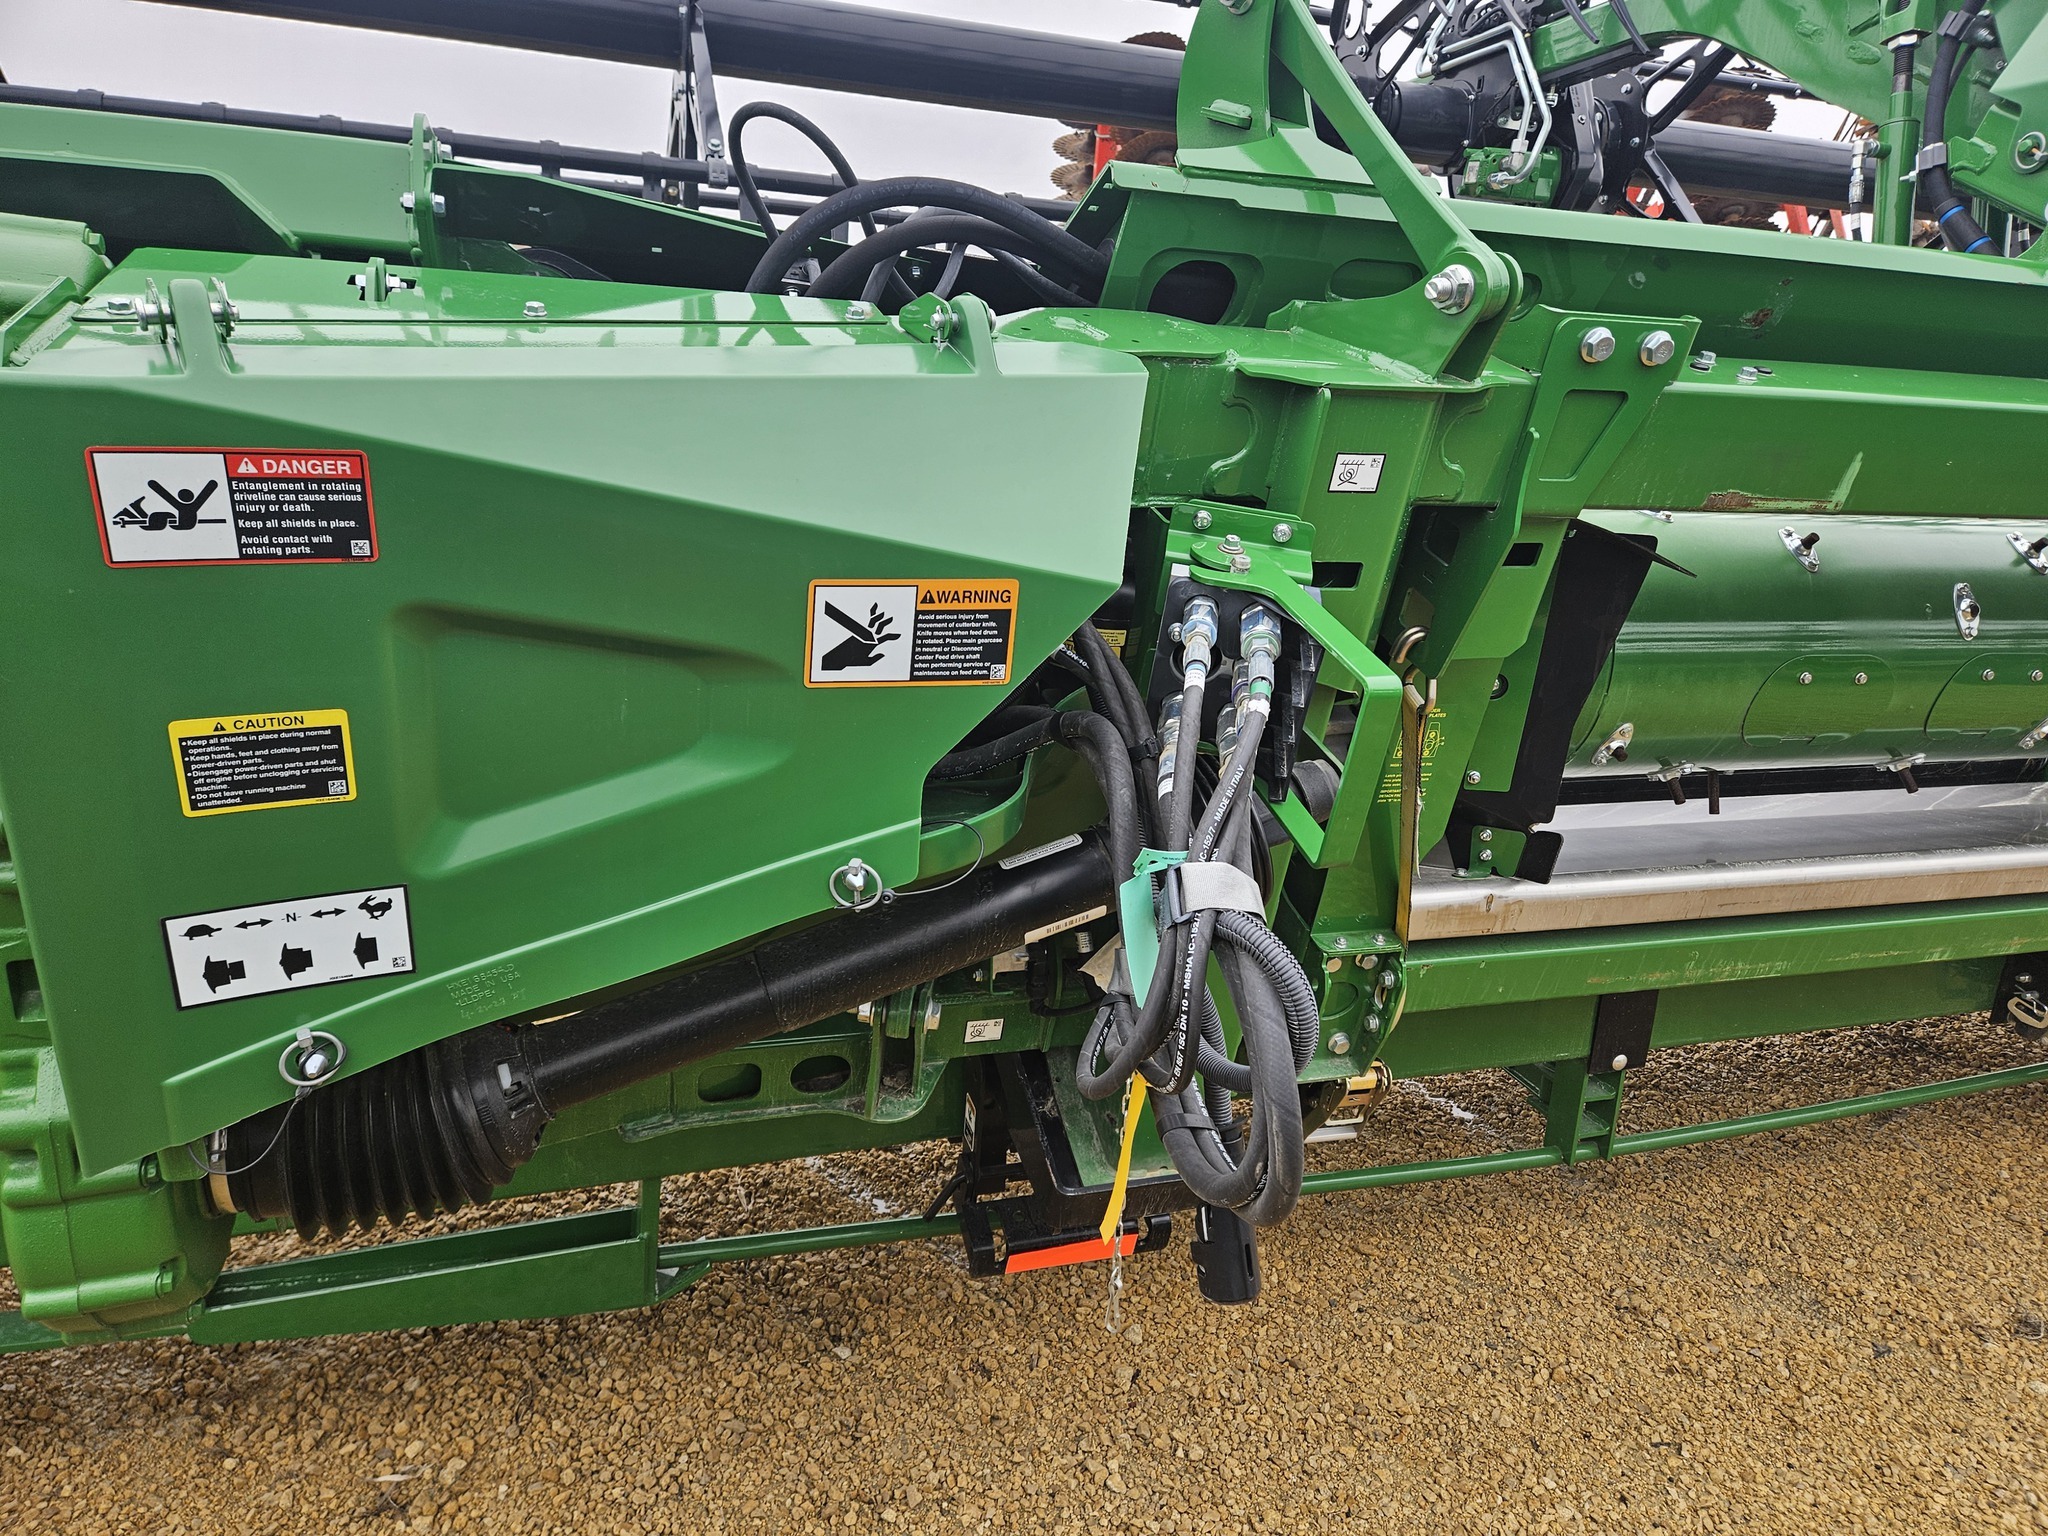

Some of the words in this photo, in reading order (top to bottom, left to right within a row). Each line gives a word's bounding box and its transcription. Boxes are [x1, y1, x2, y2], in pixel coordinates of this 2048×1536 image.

[262, 459, 351, 475] DANGER
[232, 481, 305, 491] Entanglement
[308, 482, 318, 490] in
[321, 482, 361, 492] rotating
[234, 492, 276, 501] driveline
[328, 493, 362, 502] serious
[236, 503, 265, 513] injury
[269, 504, 279, 512] or
[283, 503, 314, 512] death.
[238, 519, 263, 529] Keep
[266, 519, 278, 528] all
[281, 519, 316, 528] shields
[319, 519, 327, 528] in
[330, 519, 359, 529] place.
[241, 535, 269, 544] Avoid
[272, 535, 309, 543] contact
[311, 535, 333, 543] with
[242, 546, 282, 555] rotating
[286, 546, 314, 554] parts.
[937, 590, 1011, 603] WARNING
[233, 716, 305, 730] CAUTION
[187, 739, 207, 747] Keep
[220, 735, 247, 743] shields
[258, 732, 279, 741] place
[280, 730, 304, 740] during
[189, 745, 232, 754] operations.
[190, 754, 210, 762] Keep
[212, 752, 238, 761] hands,
[270, 746, 300, 756] clothing
[302, 745, 319, 753] away
[191, 759, 241, 771] power-driven
[193, 768, 233, 778] Disengage
[235, 763, 283, 774] power-driven
[284, 761, 303, 770] parts
[206, 776, 232, 784] engine
[234, 773, 258, 781] before
[259, 769, 300, 779] unclogging
[311, 765, 344, 774] servicing
[195, 784, 230, 792] machine.
[224, 789, 243, 797] leave
[245, 786, 274, 795] running
[275, 783, 306, 791] machine
[1214, 796, 1230, 822] MADE
[1226, 786, 1235, 798] IN
[1231, 764, 1245, 788] ITALY
[198, 798, 242, 807] unattended.
[1183, 956, 1194, 990] MSHA
[451, 985, 480, 999] MADE
[485, 980, 496, 988] IN
[500, 971, 520, 983] USA
[1182, 999, 1189, 1011] 10
[1180, 1014, 1188, 1031] DN
[1178, 1032, 1186, 1050] 1SC
[1176, 1050, 1184, 1067] 857
[1174, 1064, 1182, 1077] EN
